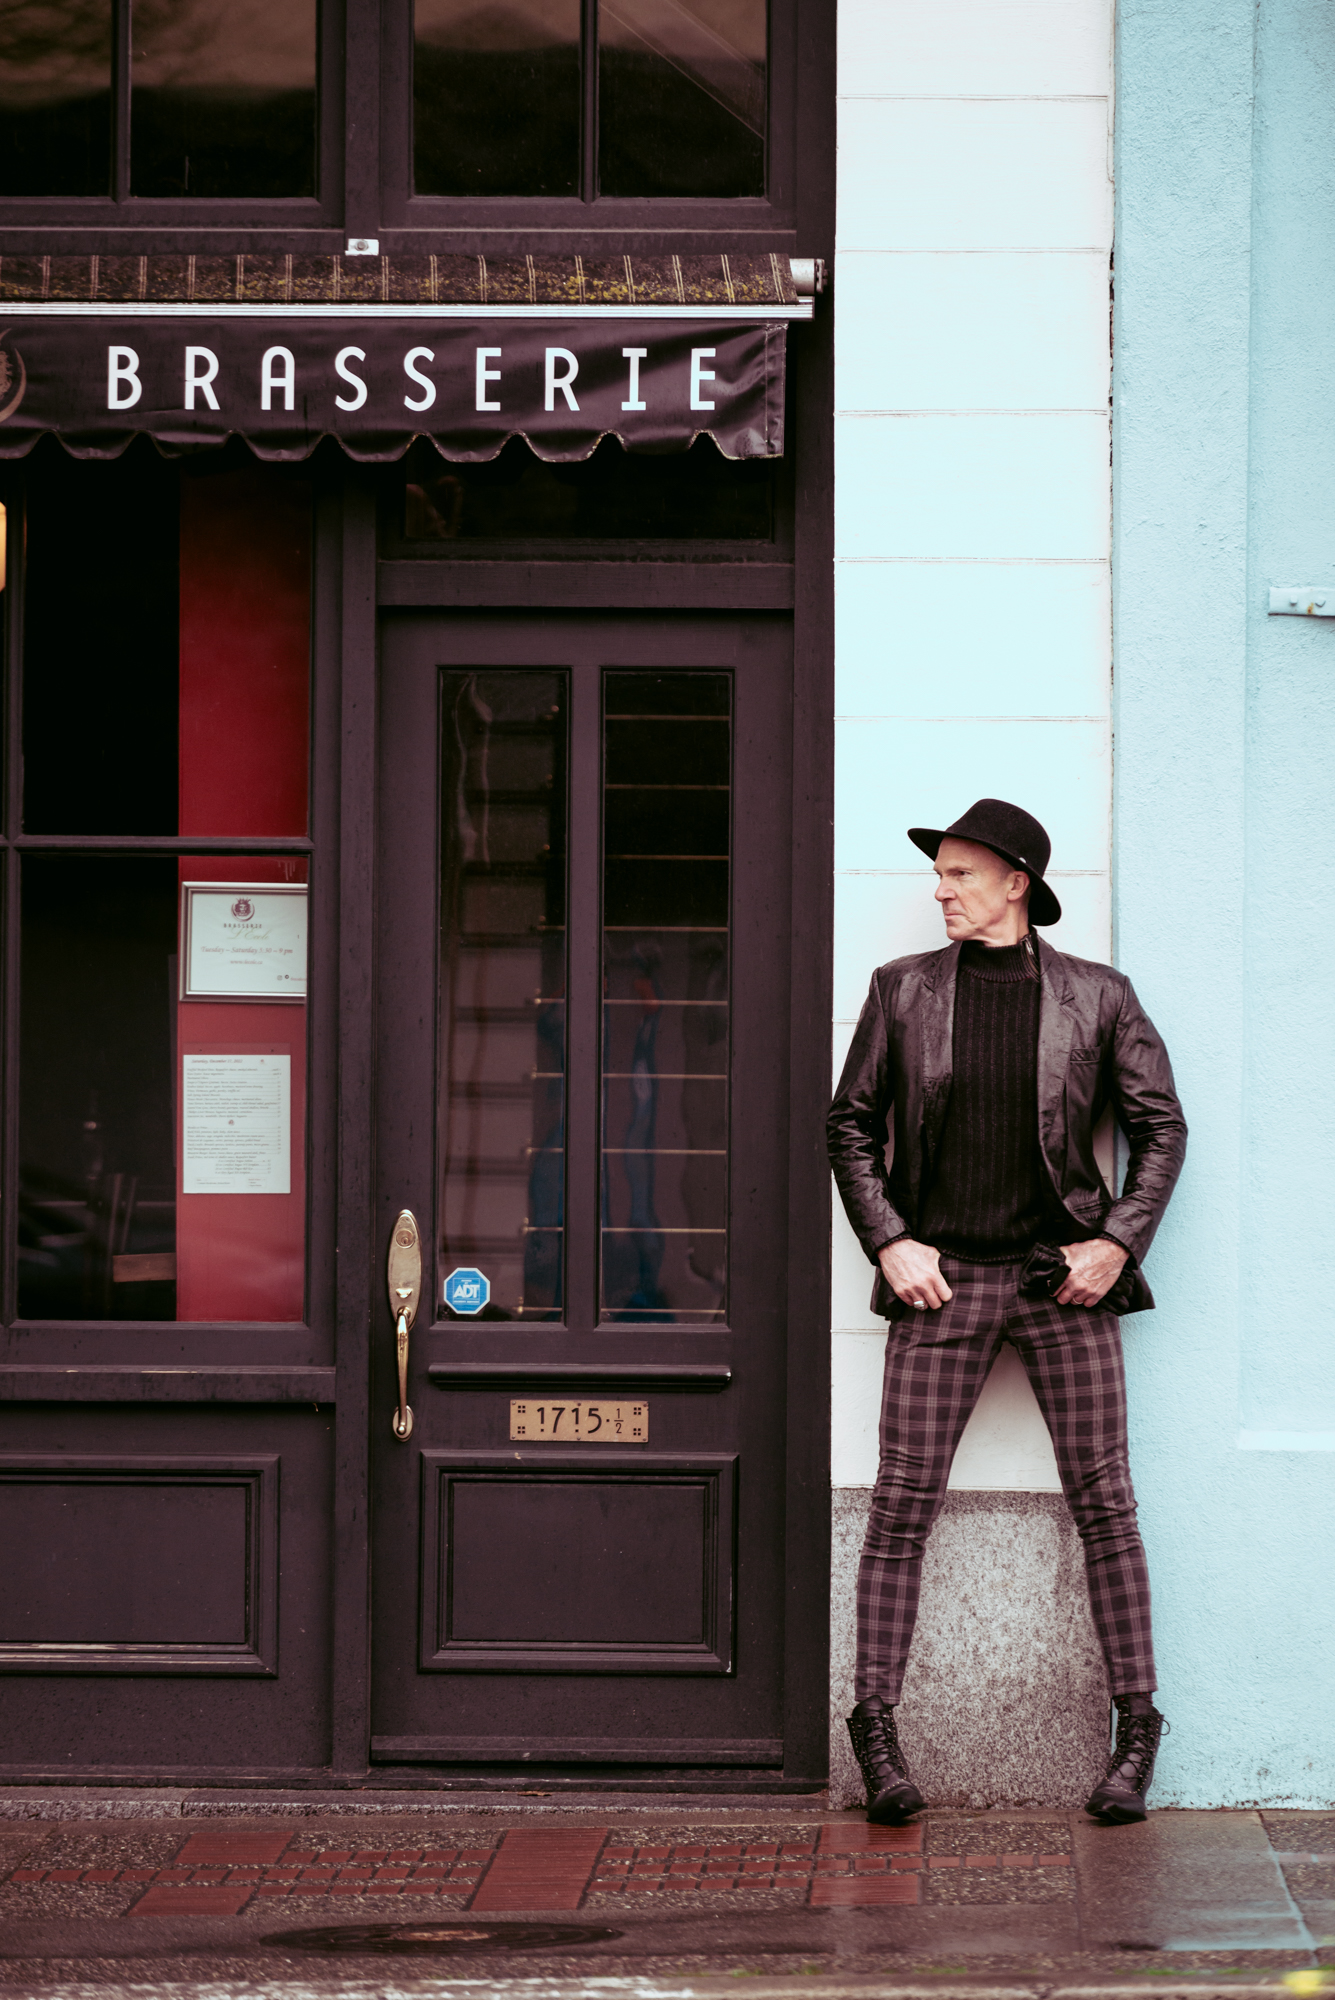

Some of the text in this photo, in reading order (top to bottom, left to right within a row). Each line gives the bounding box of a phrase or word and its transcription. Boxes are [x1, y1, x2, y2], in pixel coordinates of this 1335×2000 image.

[106, 345, 718, 412] BRASSERIE
[201, 946, 224, 955] Tuesday
[231, 946, 258, 955] Saturday
[453, 1284, 480, 1298] ADT
